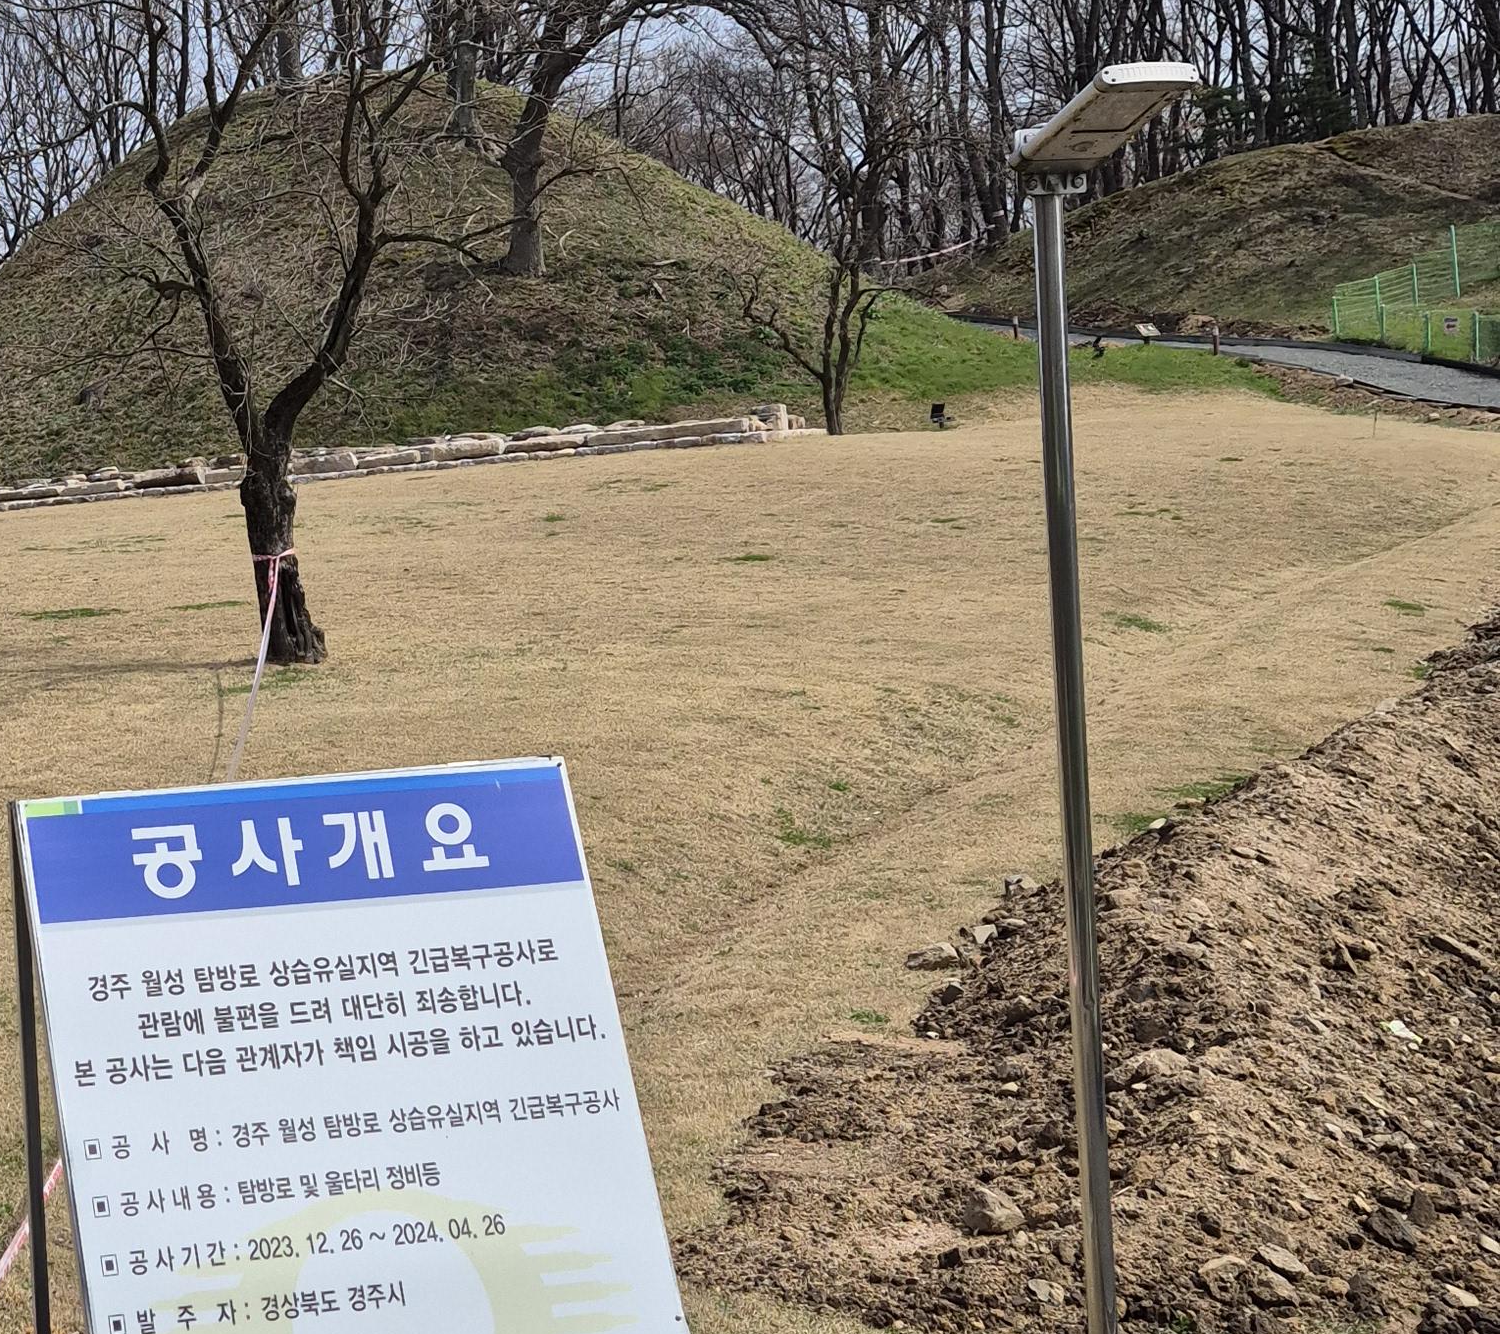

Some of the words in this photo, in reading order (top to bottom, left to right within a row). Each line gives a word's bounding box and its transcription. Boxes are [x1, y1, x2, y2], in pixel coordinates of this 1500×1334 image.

[130, 801, 491, 900] 공사개요
[86, 972, 133, 1003] 경주
[140, 967, 186, 999] 월성
[192, 962, 262, 995] 탐방로
[268, 949, 401, 989] 상습유실지역
[406, 937, 560, 976] 긴급복구공사로
[136, 1006, 207, 1041] 관람에
[212, 1000, 281, 1035] 불편을
[288, 995, 334, 1026] 드려
[340, 989, 409, 1023] 대단히
[414, 979, 533, 1016] 죄송합니다.
[73, 1058, 98, 1089] 본
[104, 1052, 175, 1086] 공사는
[181, 1046, 228, 1078] 다음
[234, 1037, 326, 1074] 관계자가
[332, 1033, 379, 1065] 책임
[385, 1026, 452, 1060] 시공을
[457, 1023, 505, 1053] 하고
[510, 1013, 607, 1049] 있습니다.
[230, 1120, 272, 1150] 경주
[276, 1115, 318, 1145] 월성
[321, 1110, 384, 1141] 탐방로
[387, 1097, 503, 1135] 상습유실지역
[507, 1086, 622, 1123] 긴급복구공사
[236, 1175, 297, 1206] 탐방로
[298, 1171, 321, 1200] 및
[323, 1165, 382, 1198] 울타리
[384, 1160, 442, 1192] 정비등
[338, 1226, 365, 1253] 26
[480, 1212, 507, 1238] 26
[259, 1288, 342, 1323] 경상북도
[346, 1279, 407, 1313] 경주시
